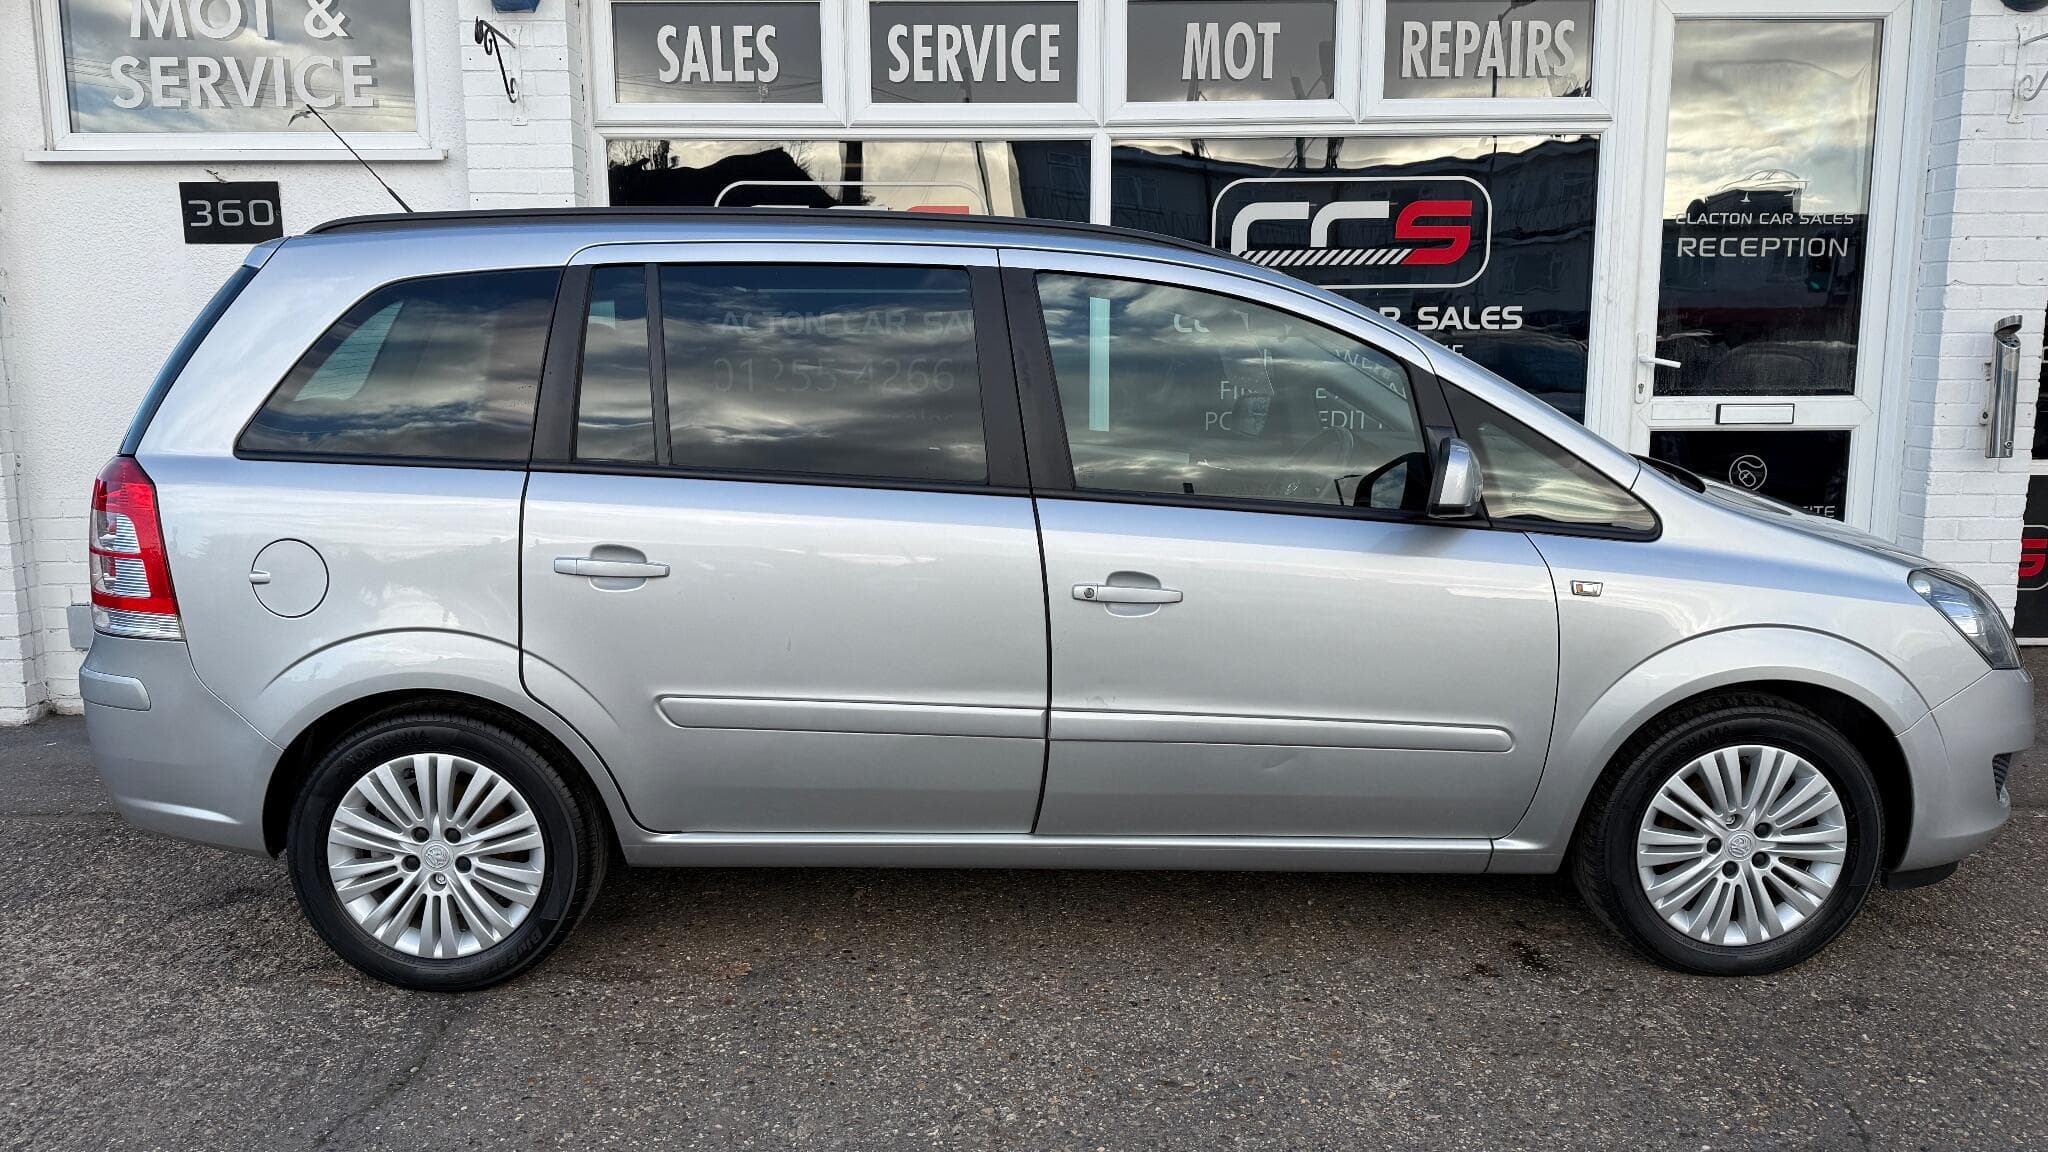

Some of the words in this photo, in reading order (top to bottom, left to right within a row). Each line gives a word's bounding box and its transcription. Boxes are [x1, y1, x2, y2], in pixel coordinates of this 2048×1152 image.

[129, 0, 270, 39] MOT
[303, 0, 350, 39] &
[657, 25, 780, 84] SALES
[887, 24, 1061, 83] SERVICE
[1181, 22, 1281, 80] MOT
[1401, 19, 1577, 78] REPAIRS
[110, 55, 375, 109] SERVICE
[187, 199, 275, 228] 360
[1675, 212, 1753, 225] CLACTON
[1759, 212, 1794, 225] CAR
[1800, 212, 1855, 225] SALES
[1677, 237, 1849, 258] RECEPTION
[1417, 305, 1523, 331] SALES
